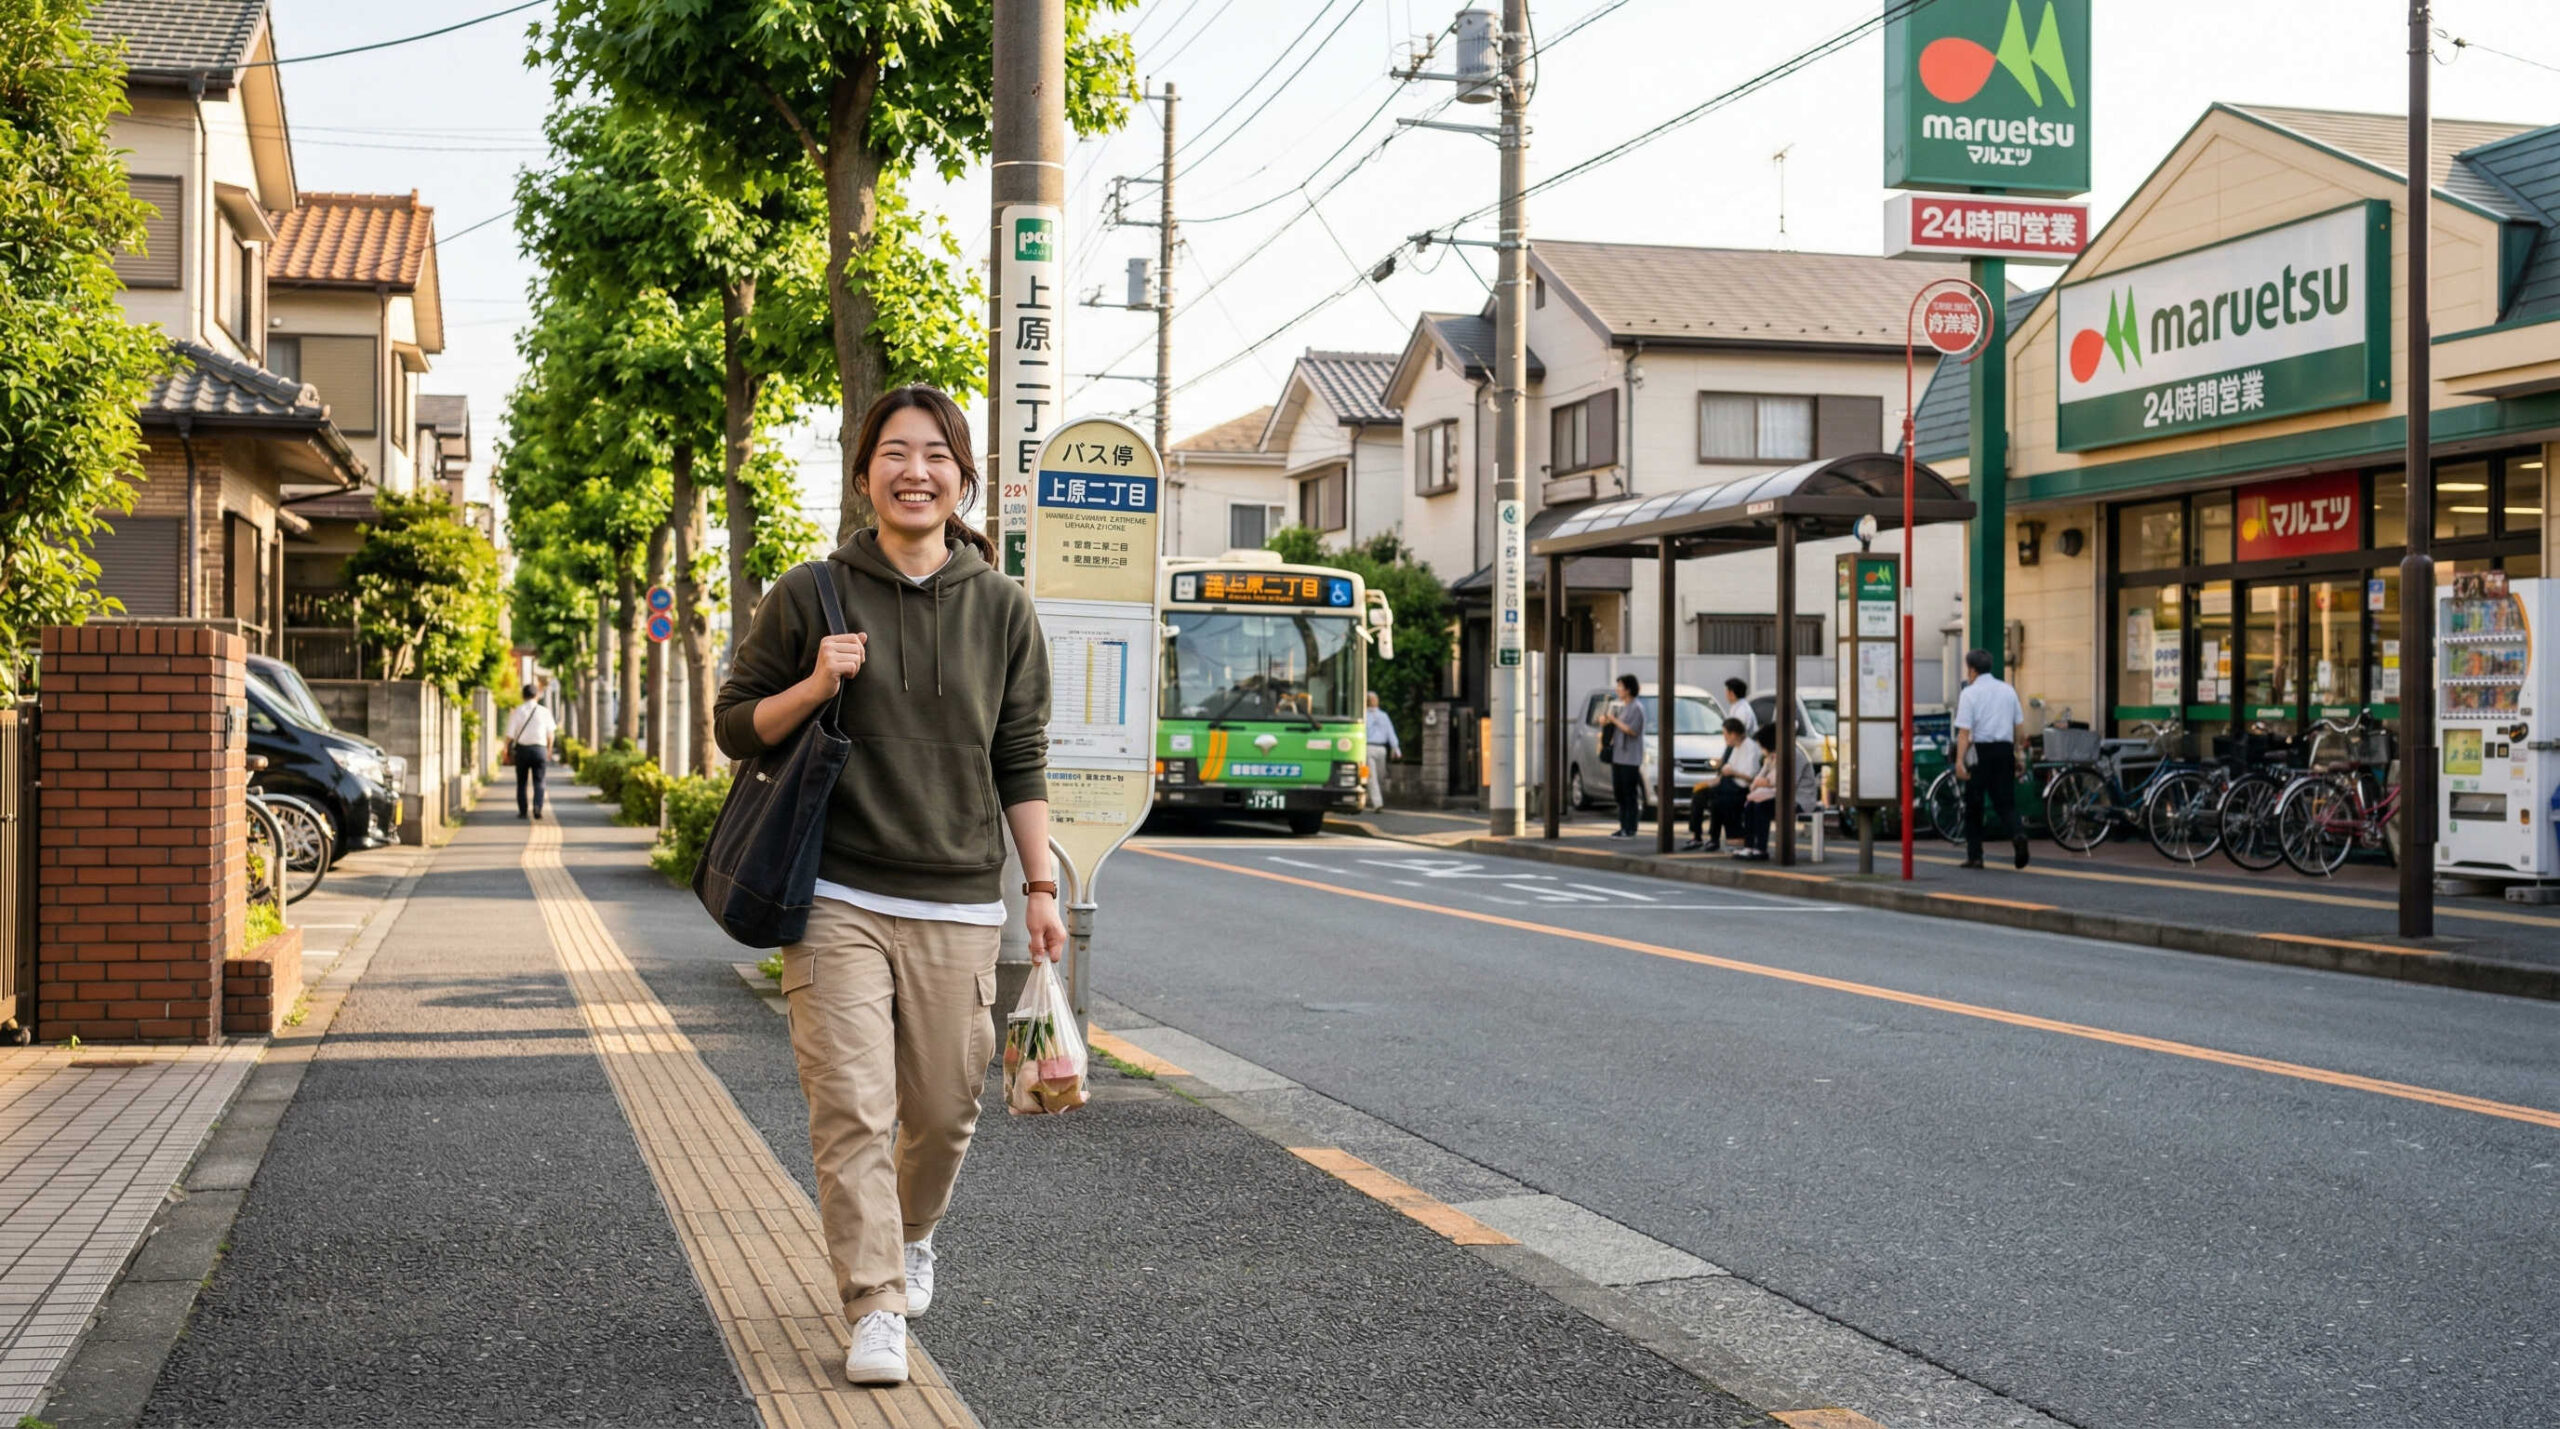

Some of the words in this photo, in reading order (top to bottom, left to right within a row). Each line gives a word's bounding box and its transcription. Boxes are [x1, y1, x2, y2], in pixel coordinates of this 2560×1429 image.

[1922, 114, 2075, 148] maruetsu
[1967, 145, 2033, 166] マルエツ
[1921, 207, 2078, 247] 24時間営業
[2151, 263, 2348, 354] maruetsu
[2143, 369, 2265, 428] 24時間営業
[1063, 443, 1134, 466] バス停
[1047, 477, 1146, 507] 上原二丁目
[2270, 496, 2351, 537] マルエツ
